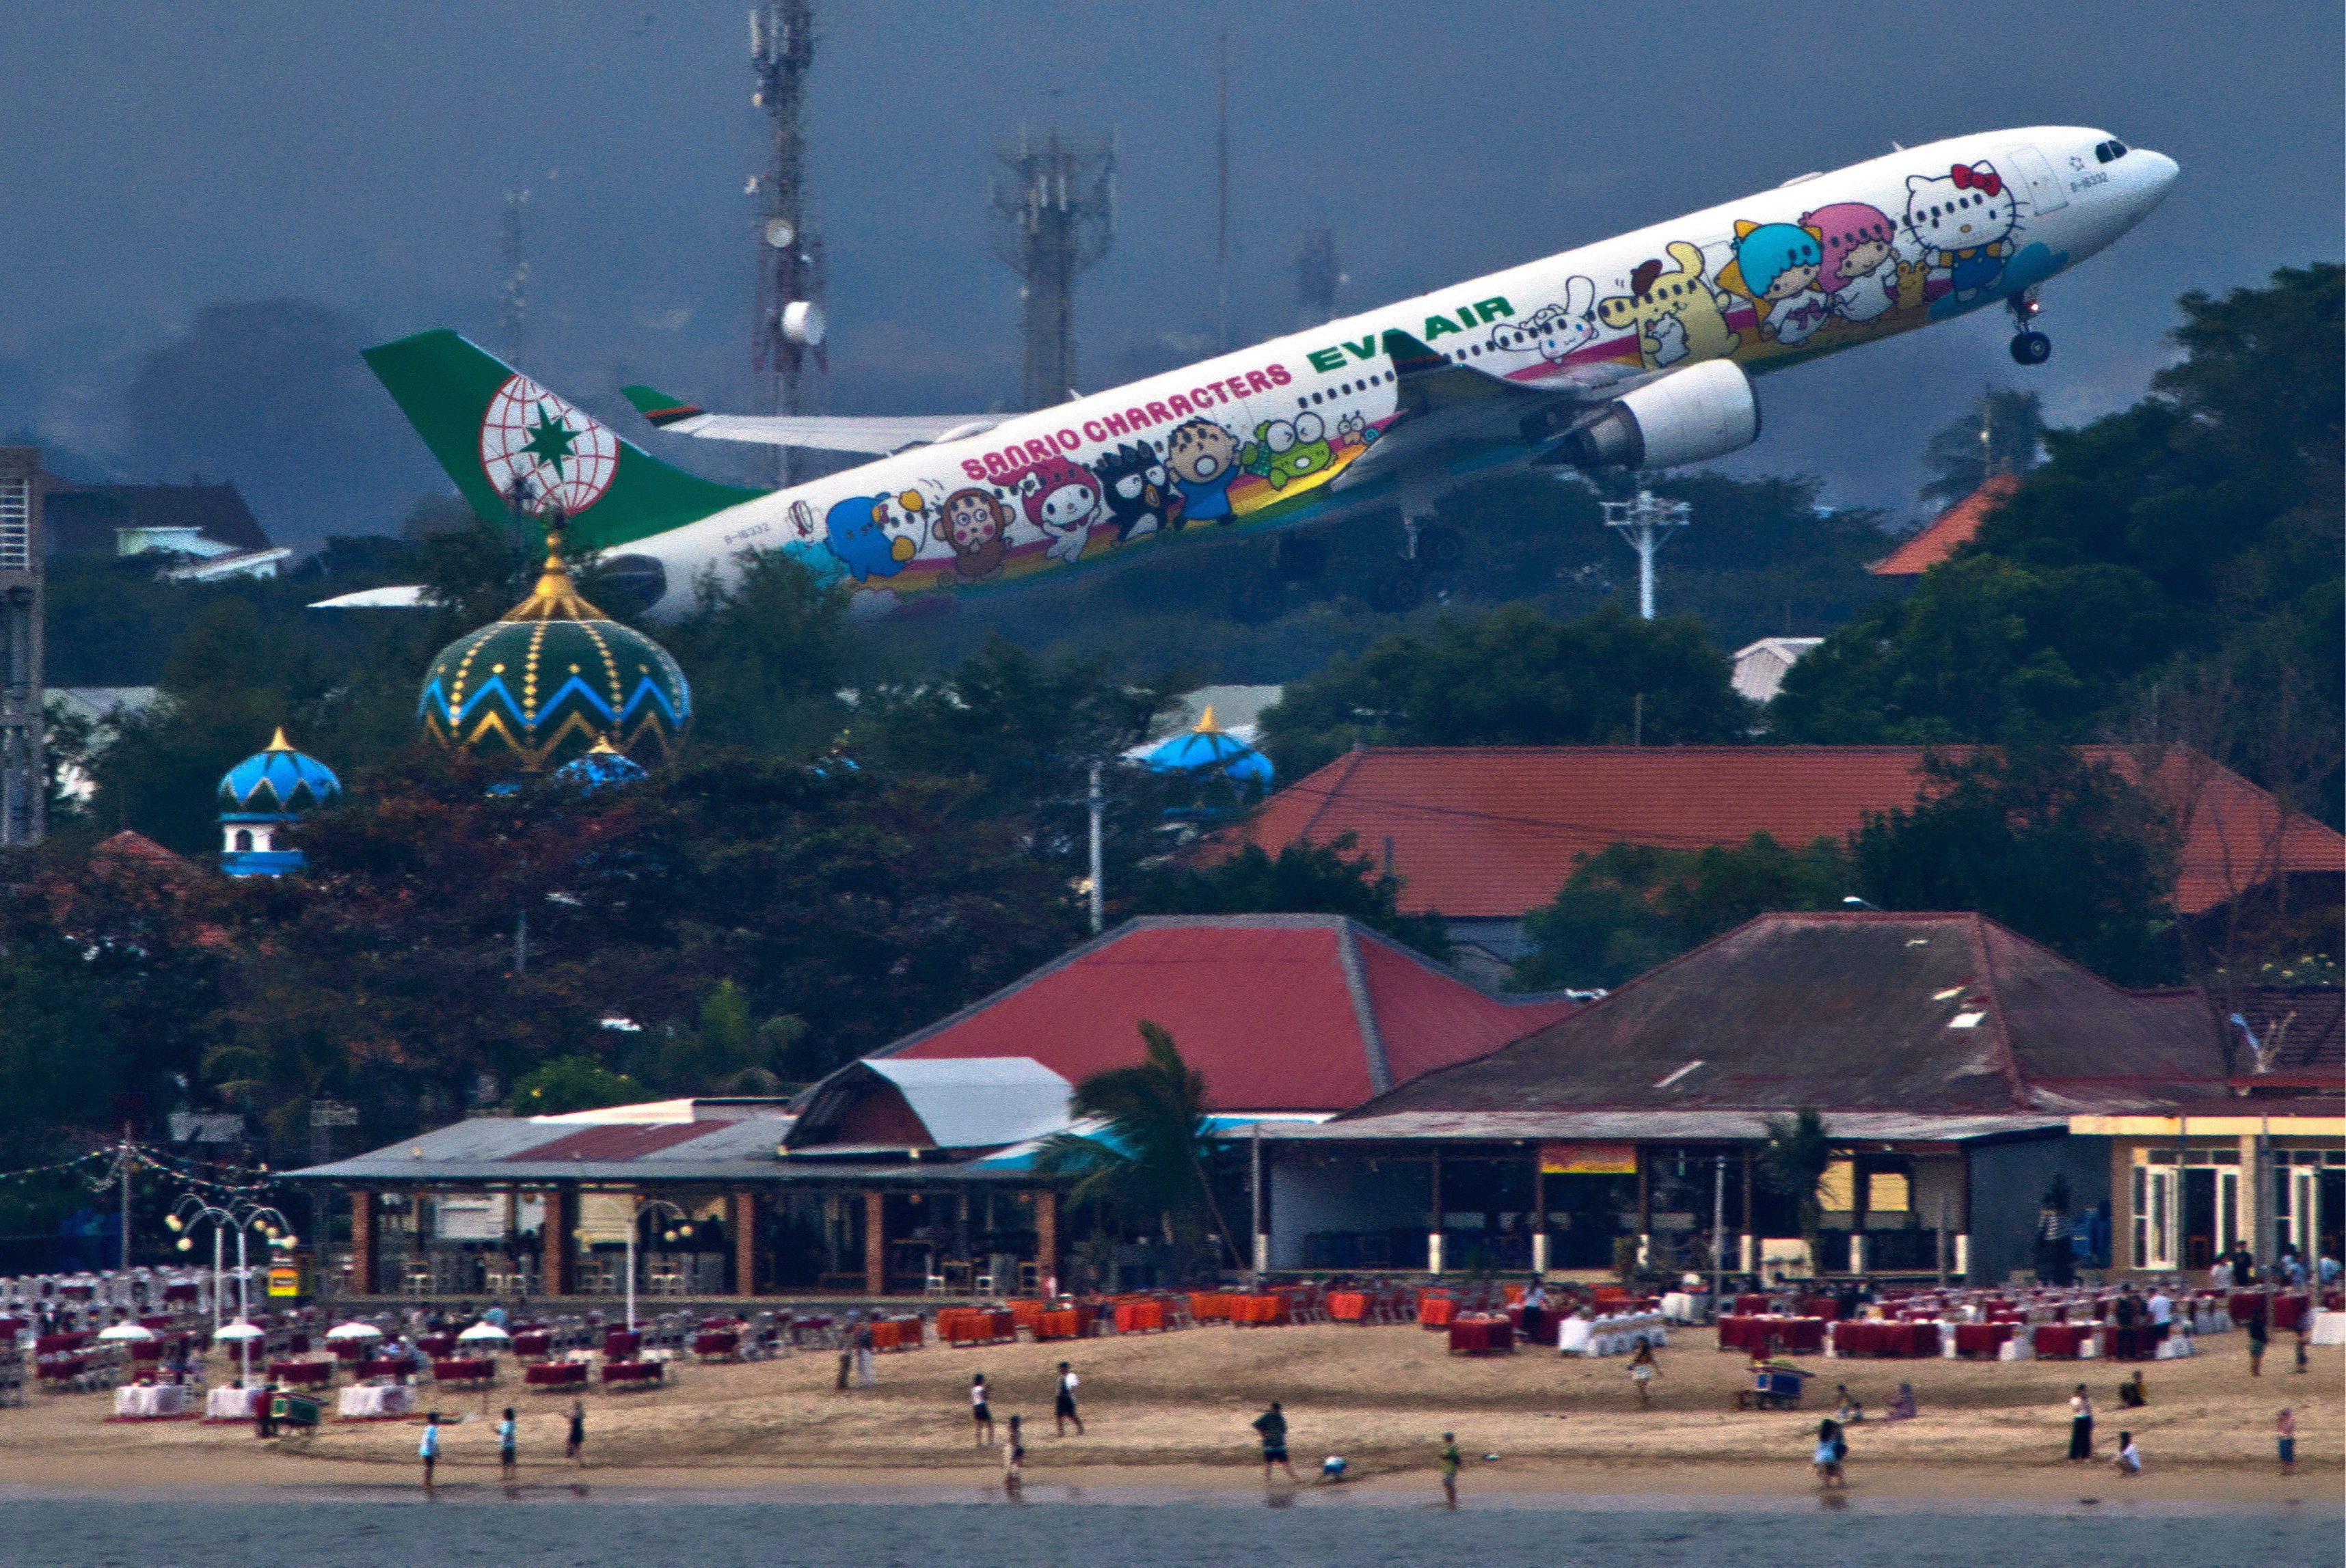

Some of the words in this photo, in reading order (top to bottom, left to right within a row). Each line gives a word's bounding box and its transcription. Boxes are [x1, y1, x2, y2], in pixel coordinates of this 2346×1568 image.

[1424, 297, 1514, 340] AIR
[961, 428, 1081, 480] SANRIO
[1083, 364, 1291, 443] CHARACTERS
[724, 523, 770, 544] B-16332
